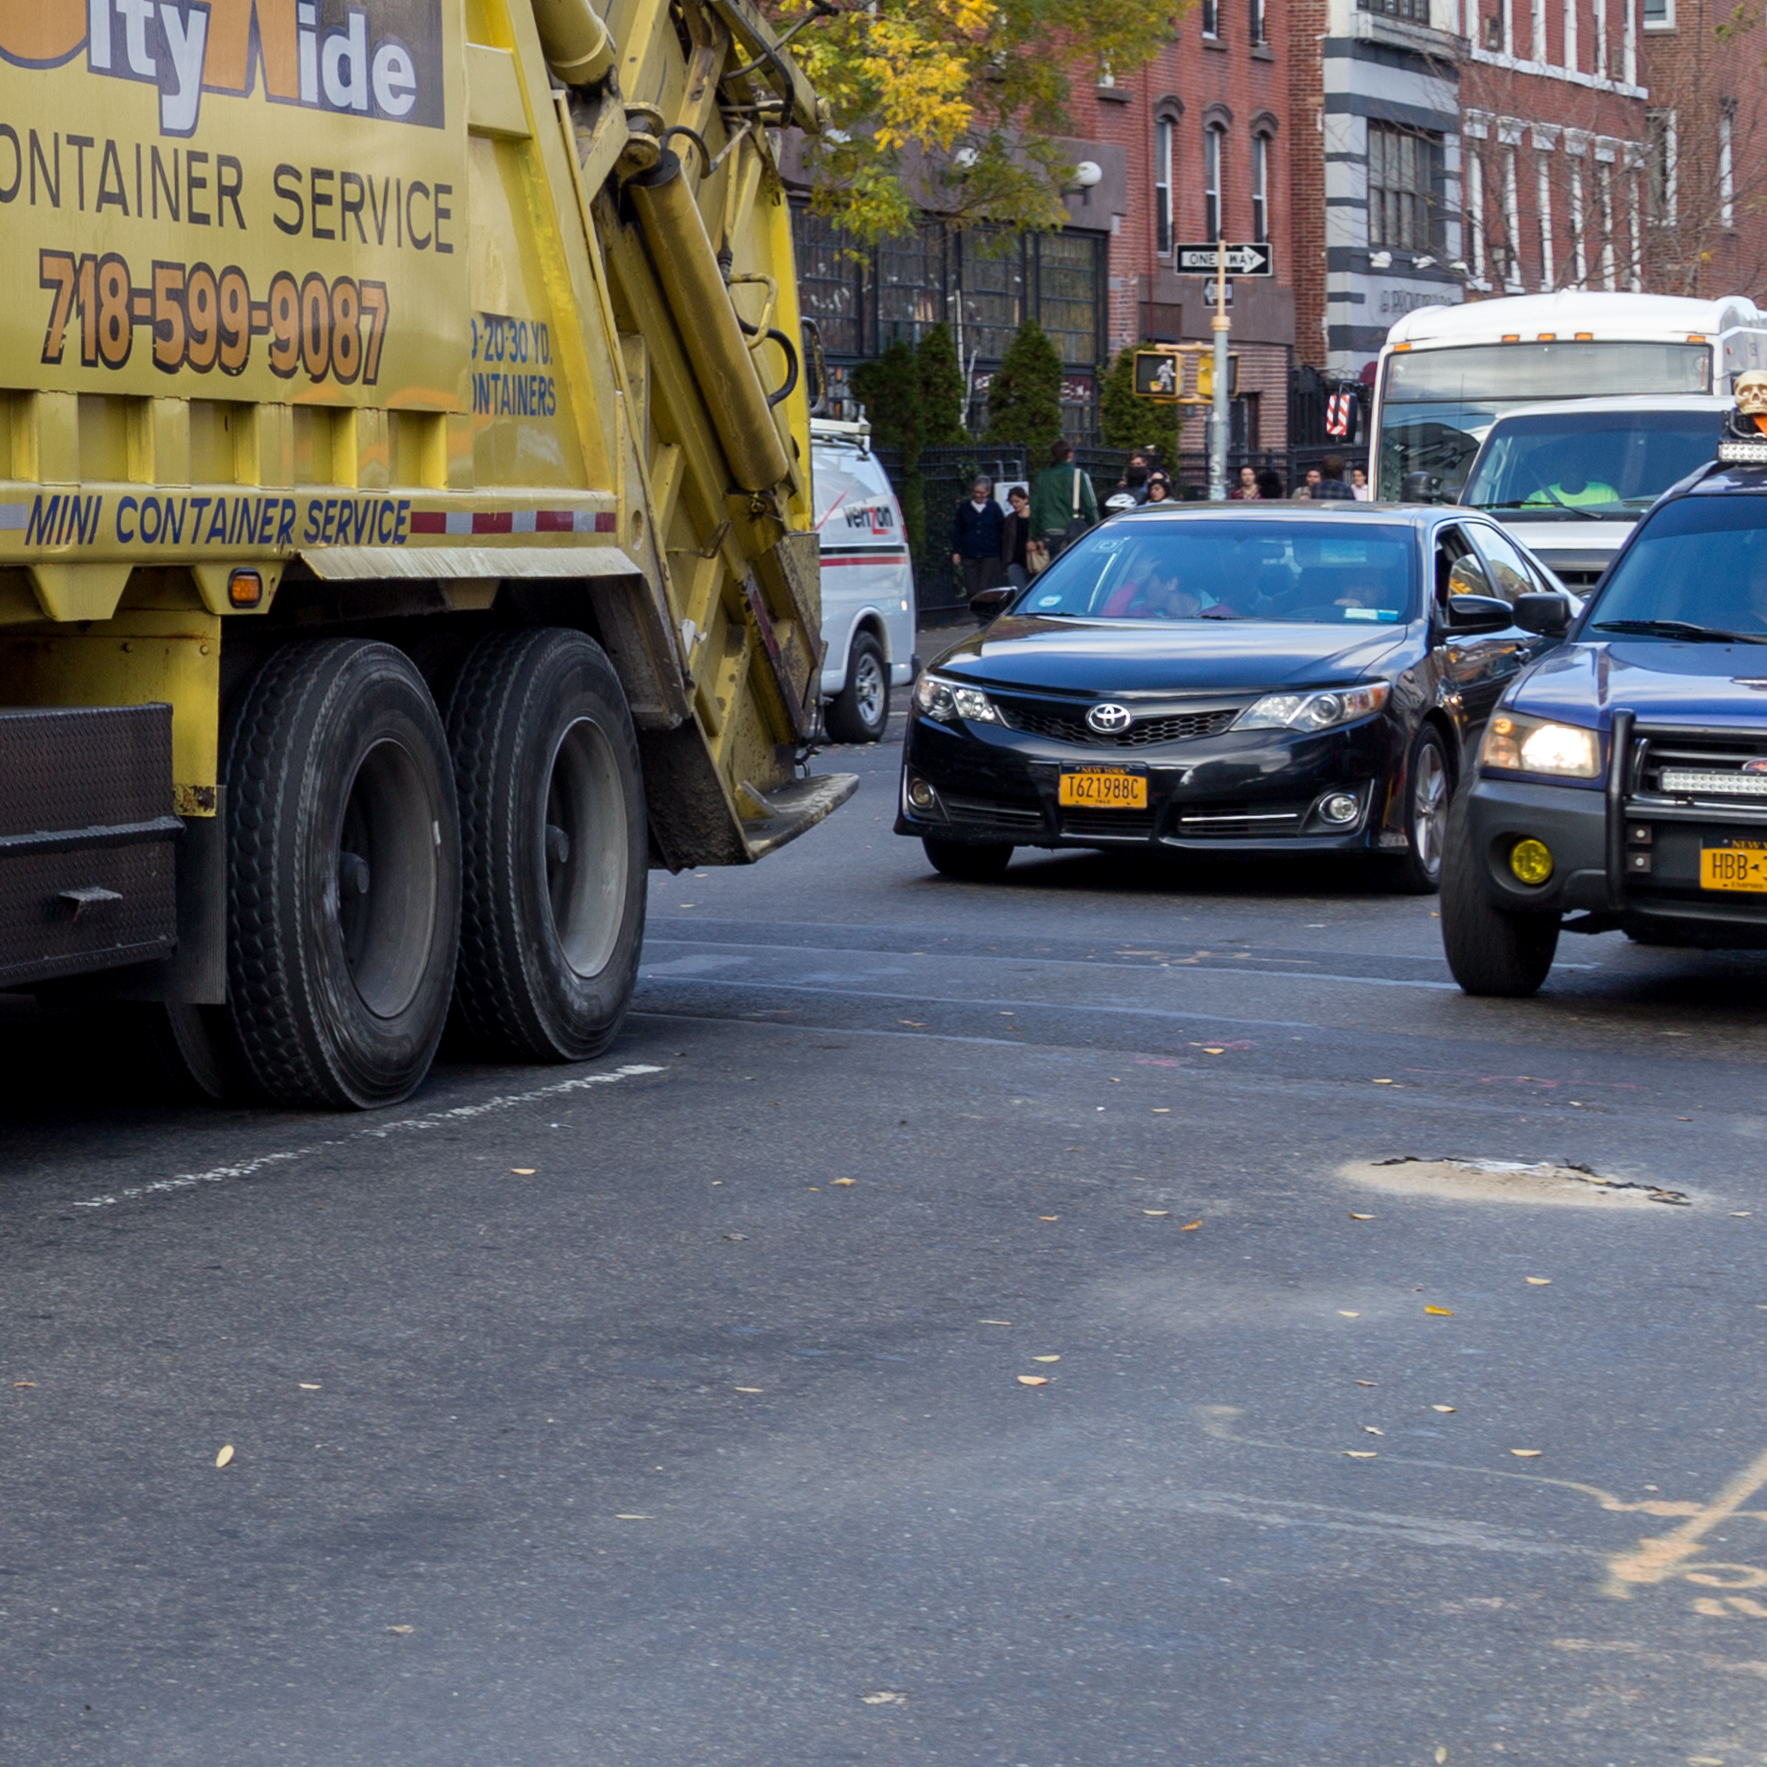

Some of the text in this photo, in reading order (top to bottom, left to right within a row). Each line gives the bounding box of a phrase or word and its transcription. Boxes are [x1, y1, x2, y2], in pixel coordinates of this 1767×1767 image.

[273, 163, 455, 254] SERVICE
[1188, 252, 1256, 266] ONE WAY
[38, 248, 390, 387] 718-599-9087
[530, 320, 554, 366] YD.
[24, 494, 412, 549] MINI CONTAINER SERVICE
[1067, 776, 1140, 800] T621988C
[1731, 839, 1760, 849] NEW
